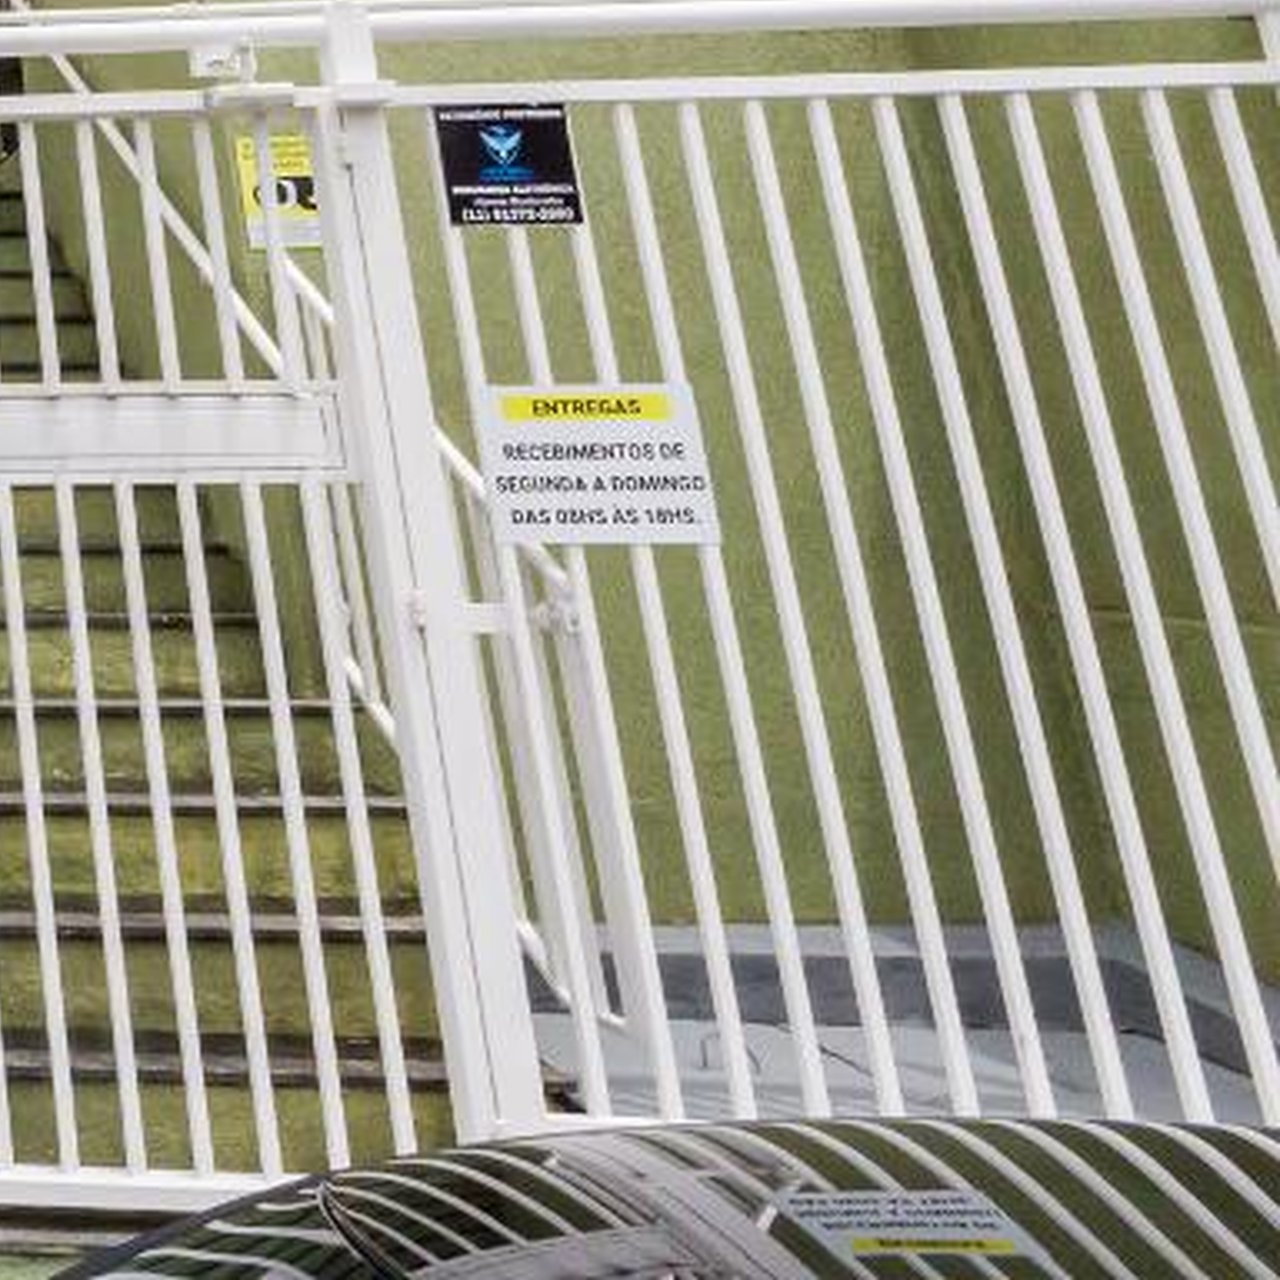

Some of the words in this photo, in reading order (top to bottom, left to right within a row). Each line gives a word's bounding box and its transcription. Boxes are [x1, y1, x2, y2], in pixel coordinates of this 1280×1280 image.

[532, 398, 642, 417] ENTREGAS
[502, 443, 656, 462] RECEBIMENTOS
[659, 443, 686, 461] DE
[495, 475, 588, 494] SEGUNDA
[593, 476, 607, 492] A
[611, 474, 708, 492] DOMINGO
[511, 509, 551, 525] DAS
